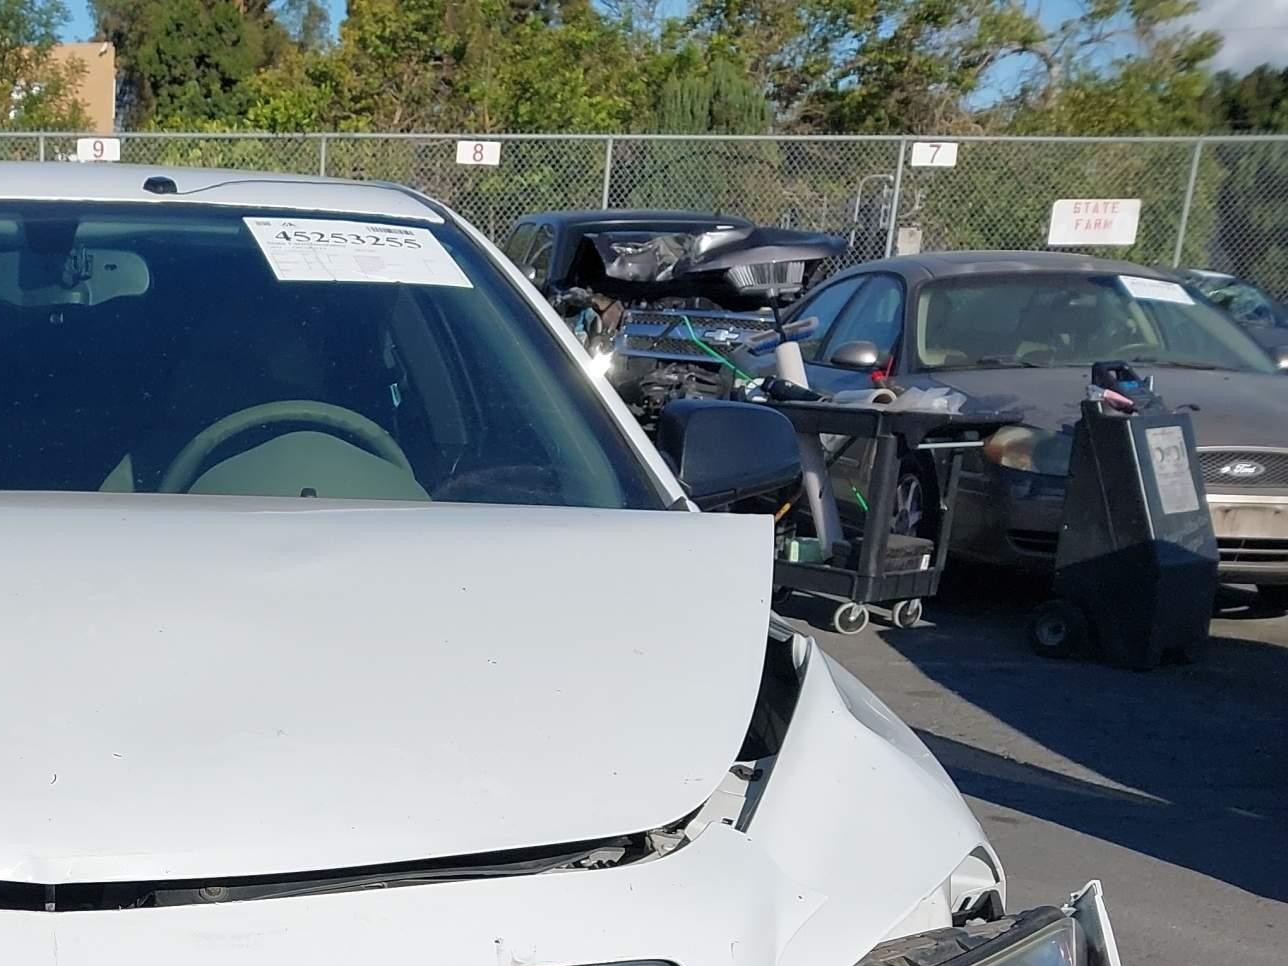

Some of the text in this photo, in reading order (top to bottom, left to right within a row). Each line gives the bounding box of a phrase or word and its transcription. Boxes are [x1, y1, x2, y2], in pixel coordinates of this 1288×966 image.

[93, 140, 104, 158] 9
[473, 143, 484, 162] 8
[929, 144, 942, 164] 7
[1073, 201, 1120, 214] STATE
[1074, 218, 1113, 231] FARM
[274, 230, 422, 249] 45253255
